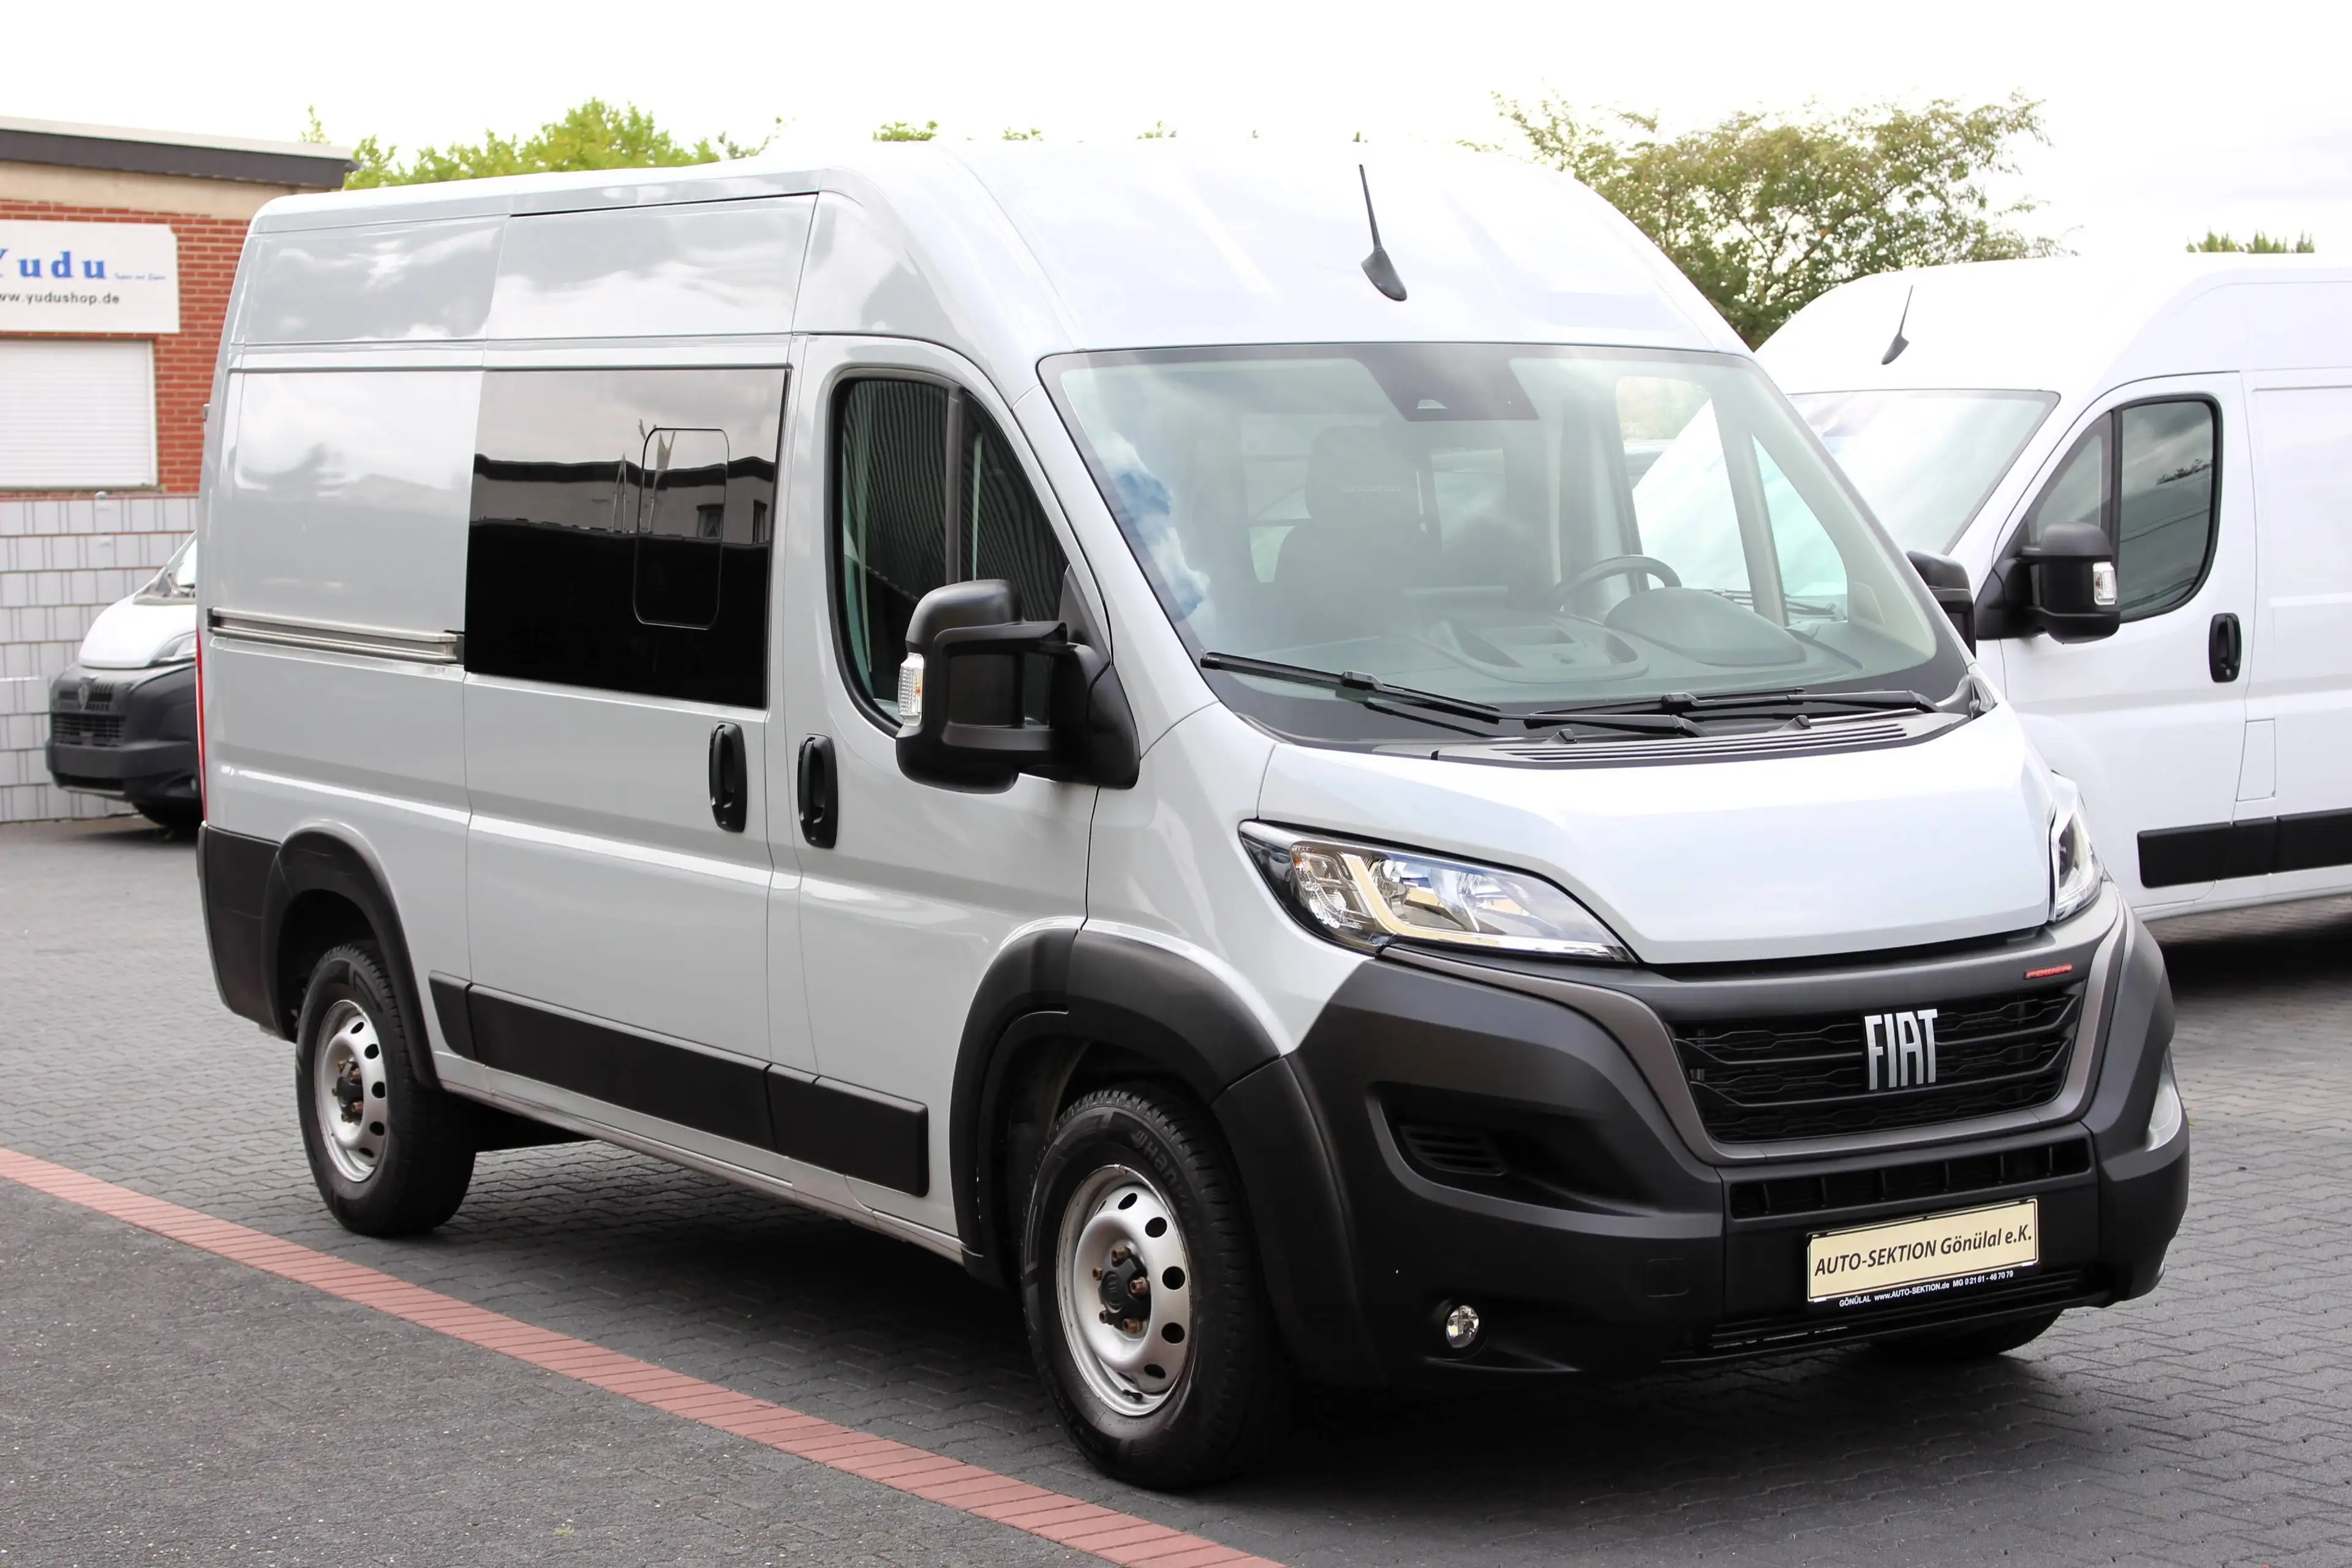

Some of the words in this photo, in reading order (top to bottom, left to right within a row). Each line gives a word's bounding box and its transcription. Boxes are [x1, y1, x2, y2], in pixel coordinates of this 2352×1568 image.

[1864, 1008, 1938, 1090] FIAT
[1814, 1239, 1936, 1276] AUTO-SEKTION
[1940, 1227, 2002, 1255] Gönülal
[2005, 1224, 2032, 1245] e.K.
[1839, 1295, 1871, 1307] GÖNÜLAL
[1874, 1281, 1950, 1302] www.AUTO-SEKTION.de
[1953, 1279, 1964, 1287] MG
